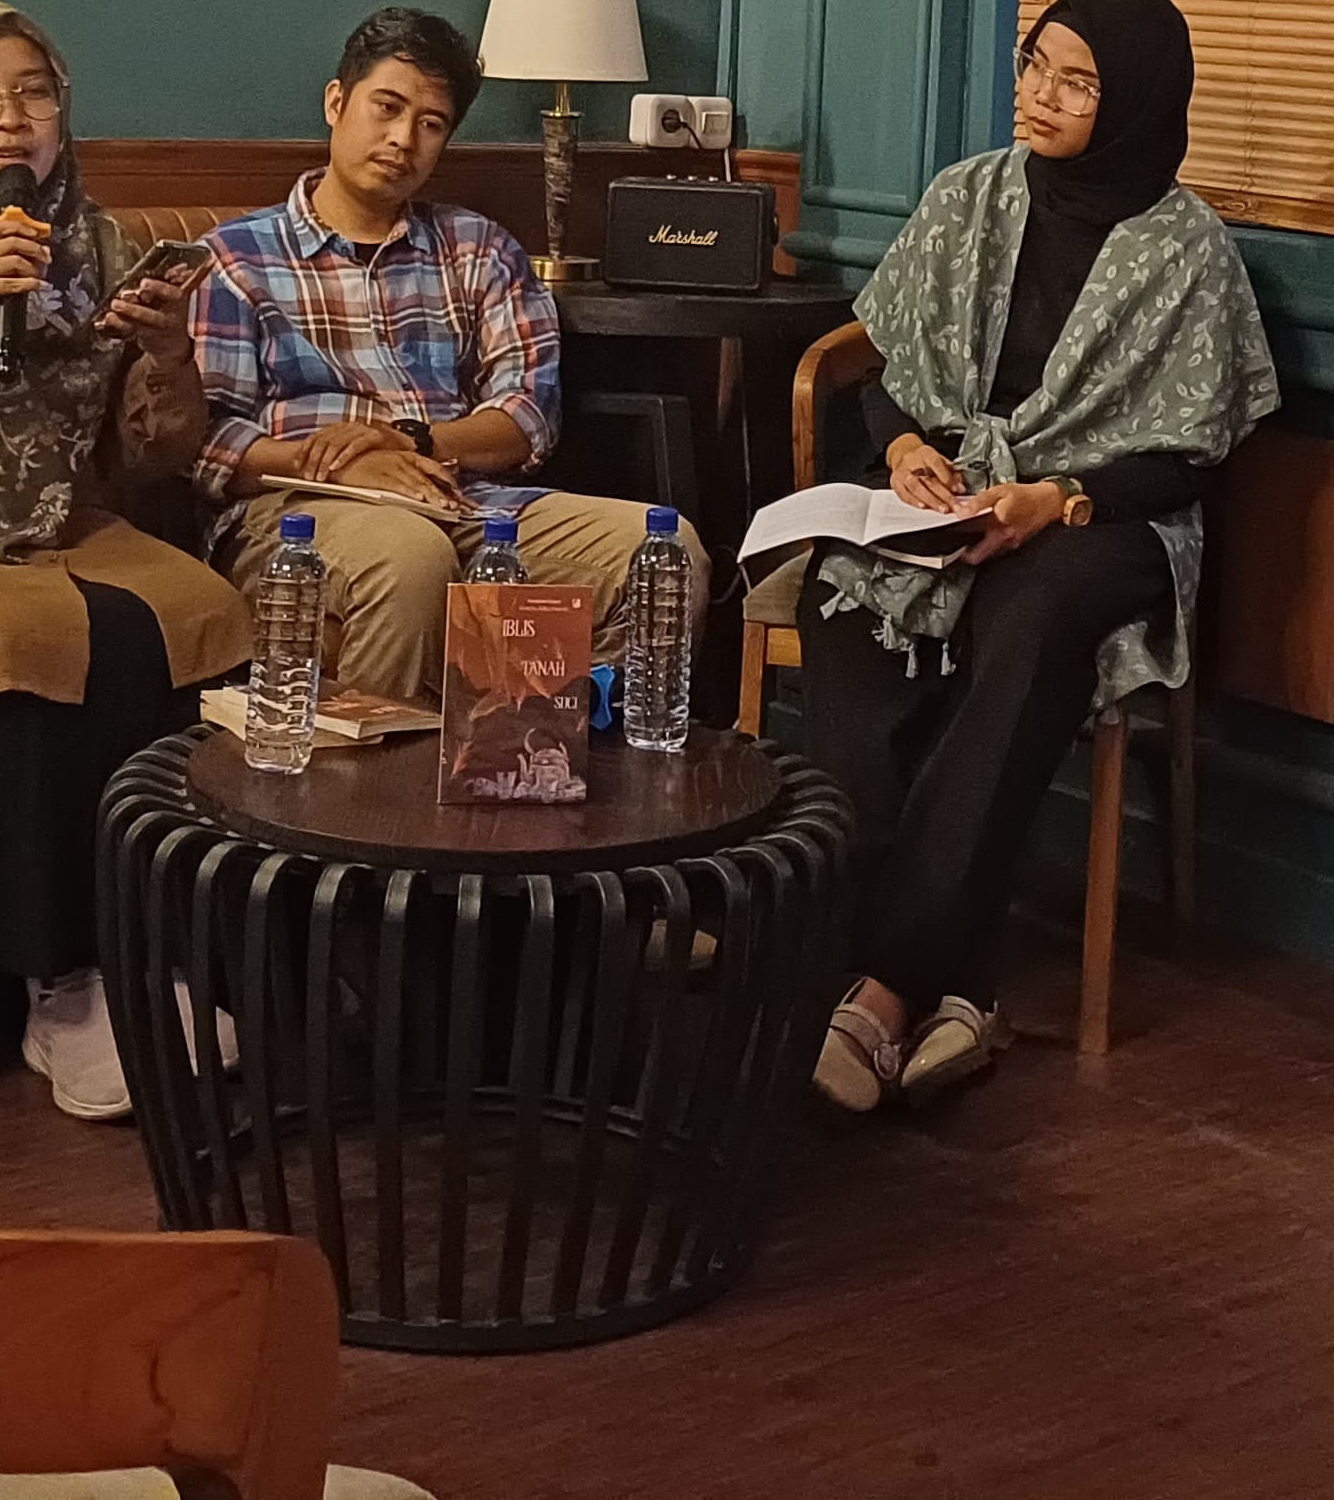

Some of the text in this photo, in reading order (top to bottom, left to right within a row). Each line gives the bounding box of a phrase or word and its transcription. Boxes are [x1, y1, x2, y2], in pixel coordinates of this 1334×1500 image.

[649, 225, 718, 246] Marshall
[502, 619, 536, 637] IBLIS
[521, 660, 565, 677] TANAH
[553, 696, 578, 710] SUCI
